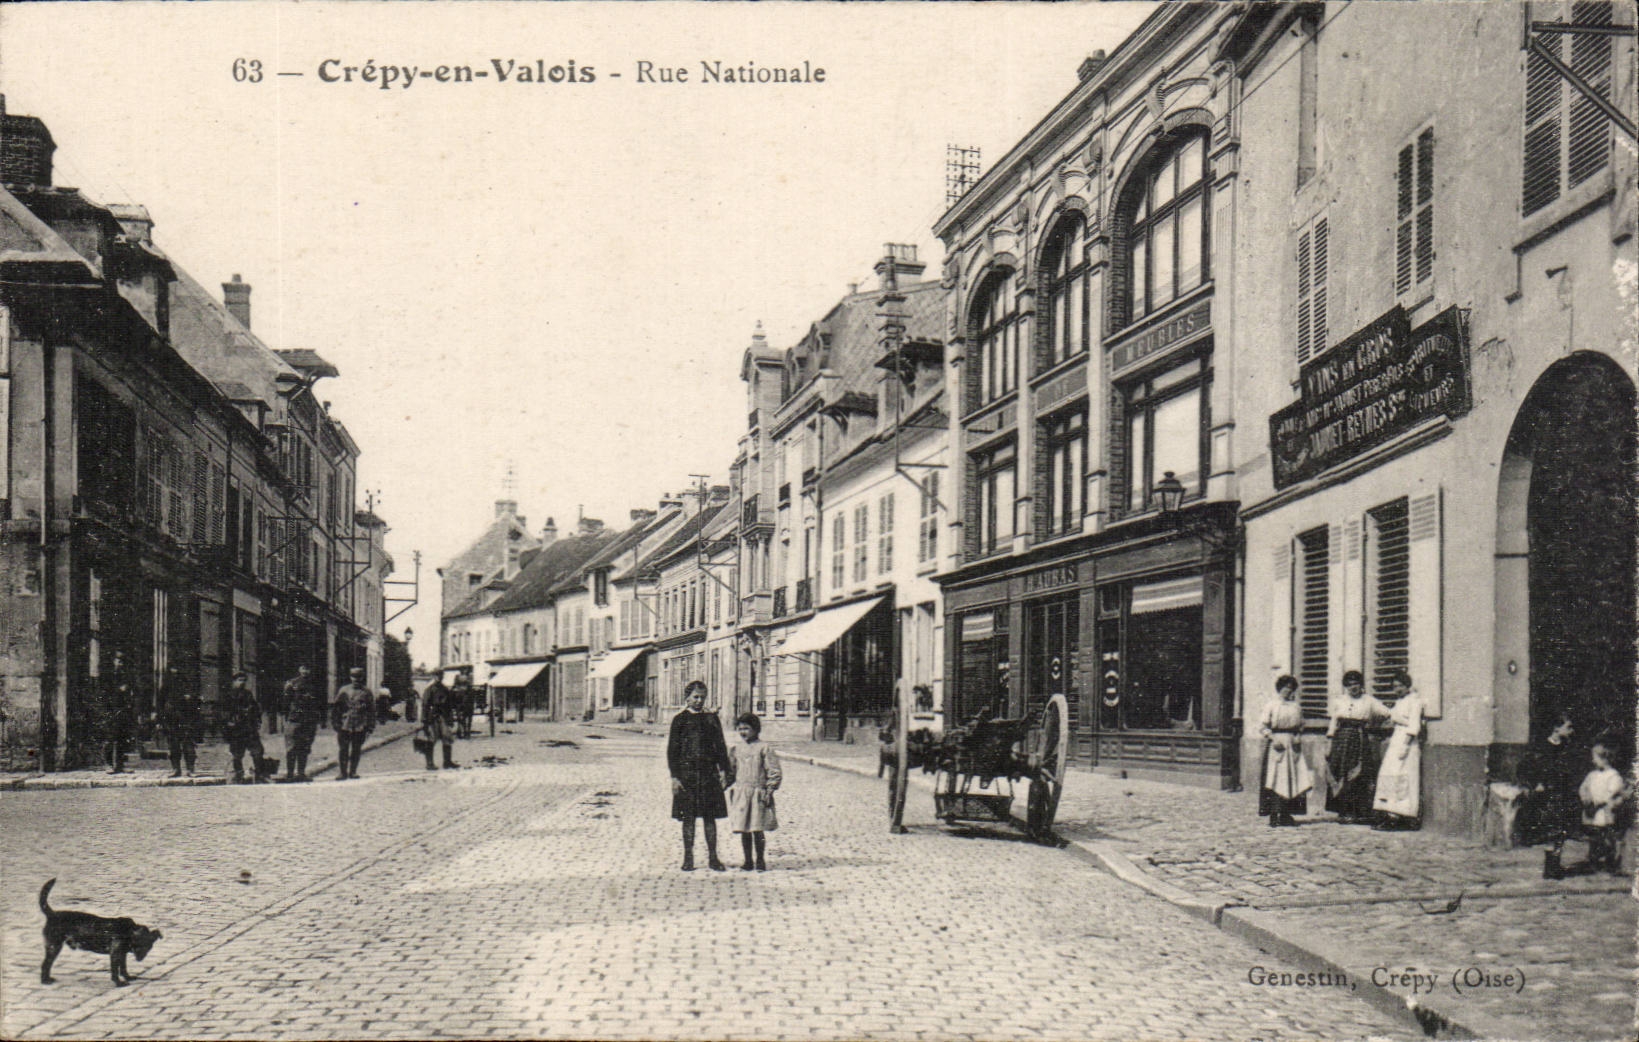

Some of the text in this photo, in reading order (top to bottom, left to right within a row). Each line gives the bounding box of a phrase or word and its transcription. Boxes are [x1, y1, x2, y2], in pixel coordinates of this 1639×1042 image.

[1126, 312, 1195, 359] MEUBLES
[1307, 360, 1340, 395] VINS
[1356, 326, 1394, 370] GROS
